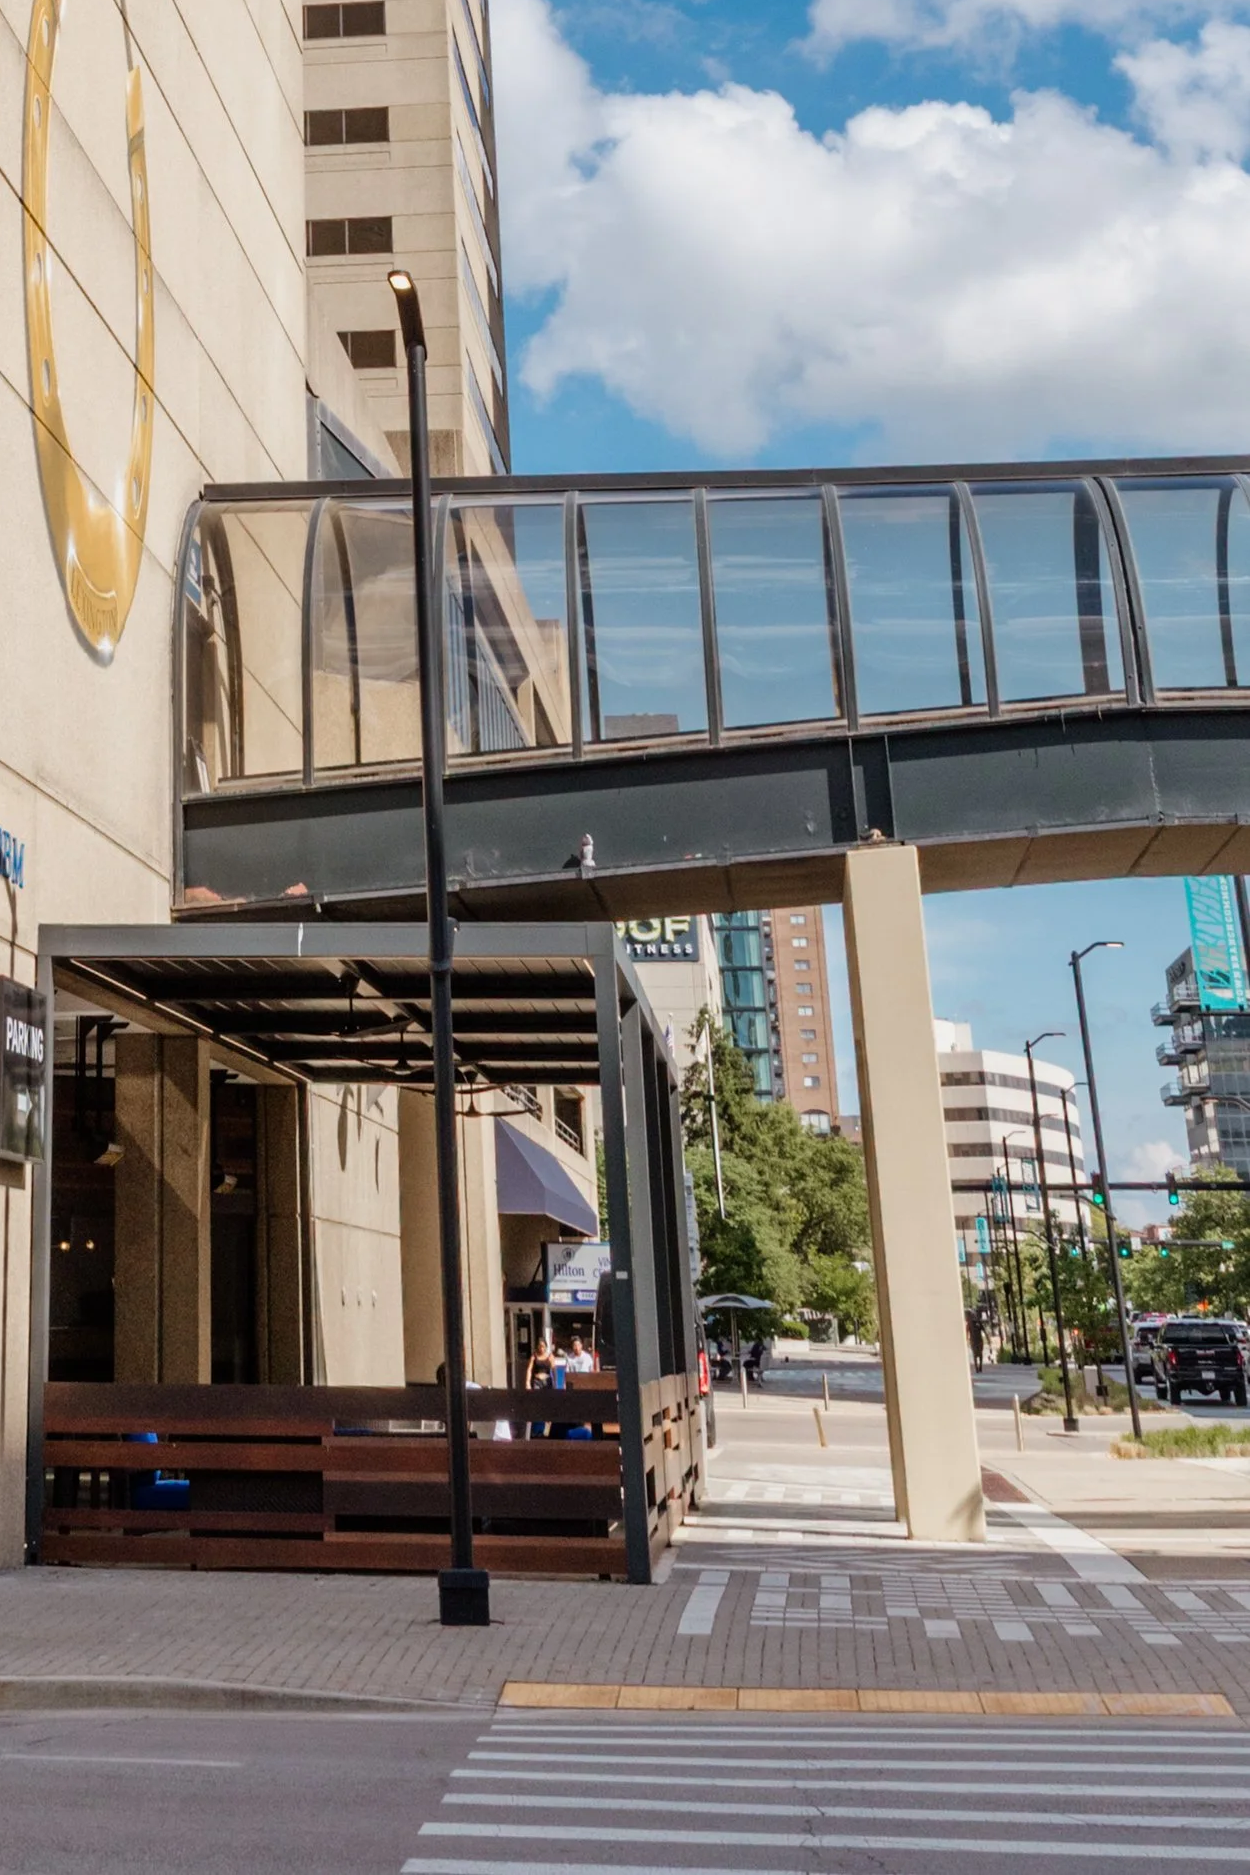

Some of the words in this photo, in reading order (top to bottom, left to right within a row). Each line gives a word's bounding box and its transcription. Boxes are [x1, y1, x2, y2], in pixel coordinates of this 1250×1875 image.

[626, 943, 693, 954] ITNESS
[6, 1015, 44, 1064] PARKING
[553, 1263, 585, 1277] Hilton
